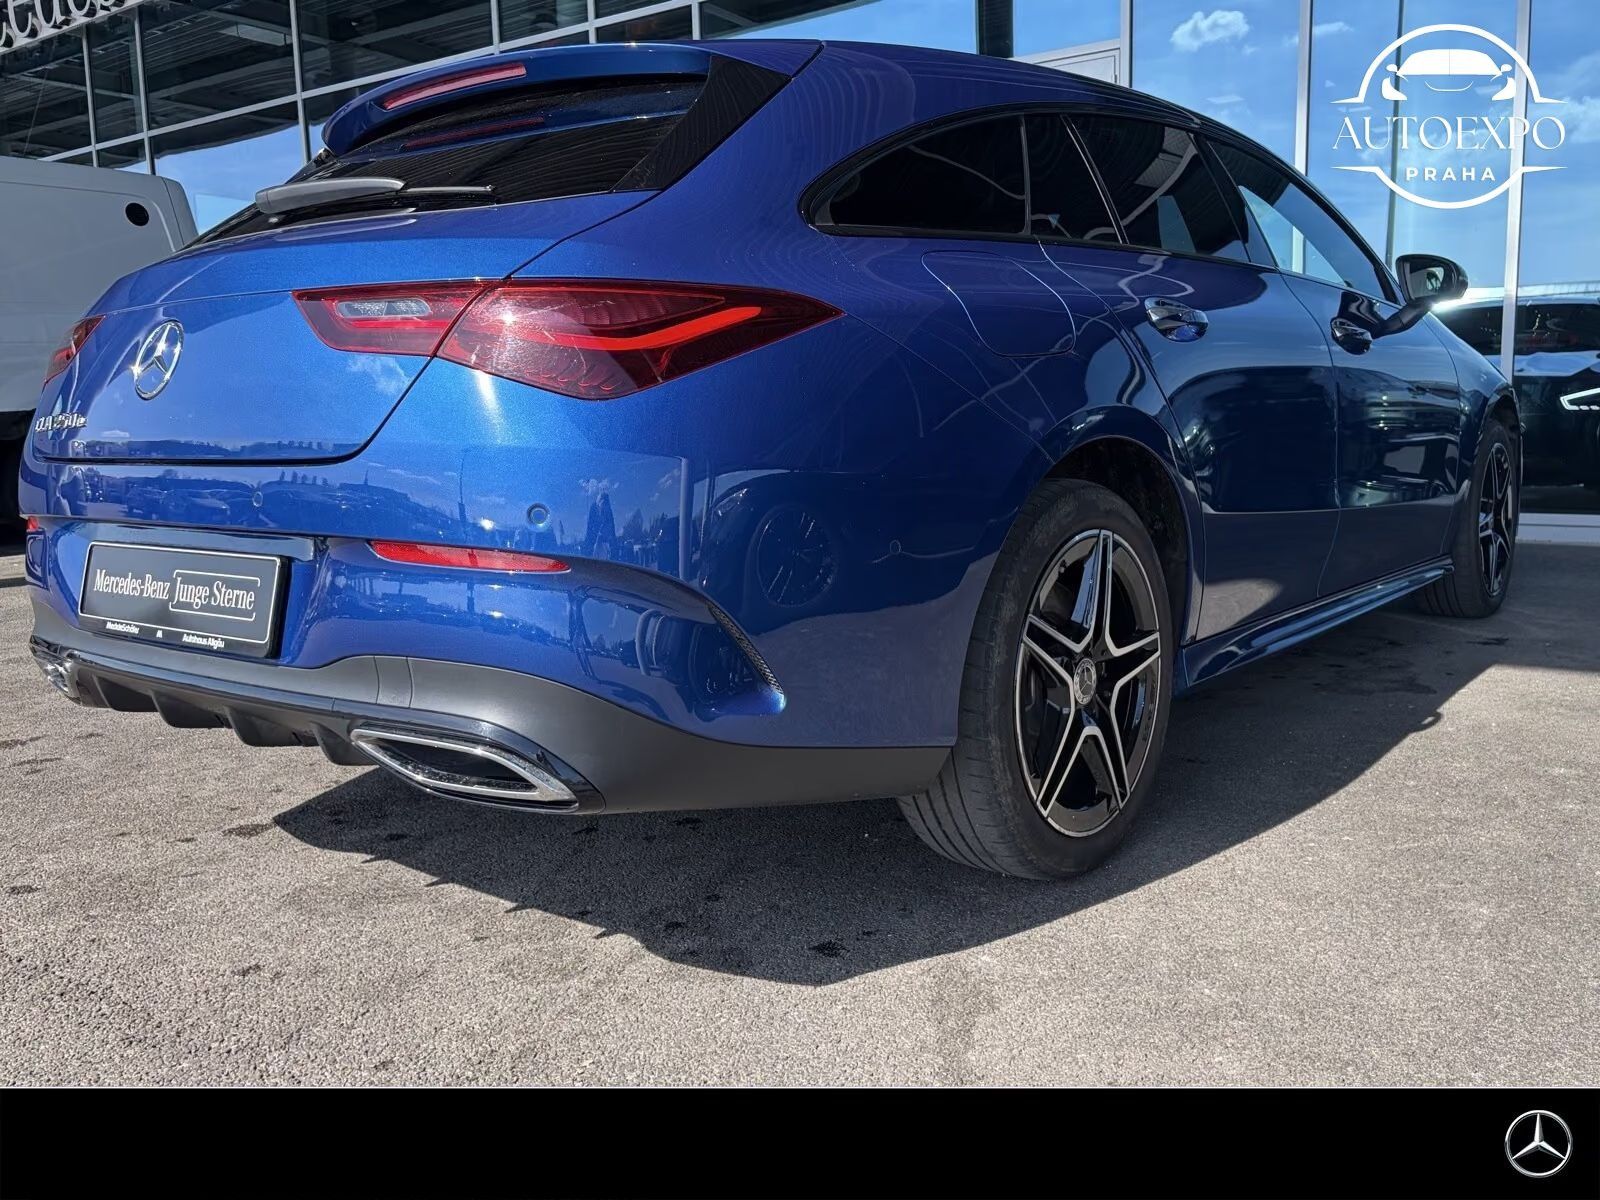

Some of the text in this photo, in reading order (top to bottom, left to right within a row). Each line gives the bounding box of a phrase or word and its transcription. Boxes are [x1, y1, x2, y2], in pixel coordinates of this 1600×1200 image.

[93, 569, 255, 610] Mercedes-Benz Junge Sterne
[182, 633, 208, 645] Autohaus
